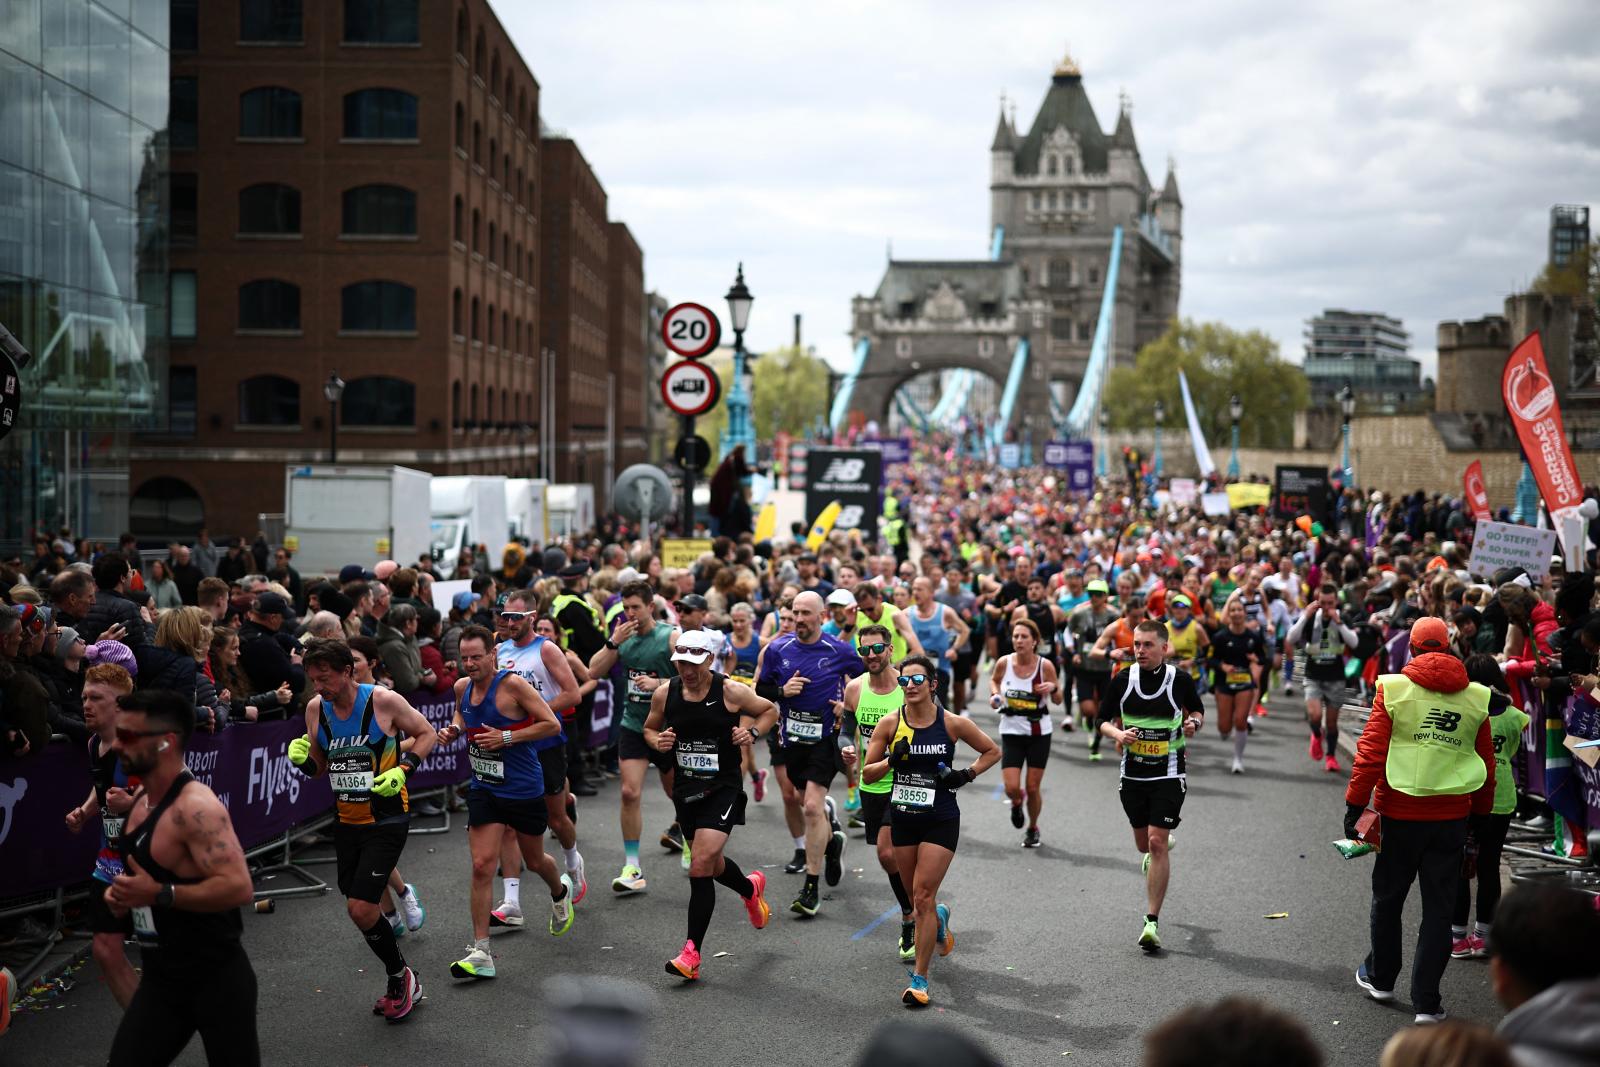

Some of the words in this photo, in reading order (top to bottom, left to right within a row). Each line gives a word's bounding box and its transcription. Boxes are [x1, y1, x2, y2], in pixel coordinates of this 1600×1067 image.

[671, 320, 707, 340] 20
[1532, 421, 1571, 505] CARRERAS
[1486, 531, 1502, 541] GO
[1488, 545, 1501, 553] SO
[1502, 547, 1530, 558] SUPER
[1475, 554, 1505, 566] PROUD
[418, 702, 456, 719] BBOTT
[860, 713, 884, 723] AFR
[1420, 708, 1462, 732] NB
[791, 723, 817, 735] 42772
[1413, 732, 1431, 741] new
[679, 740, 692, 751] tcs
[909, 743, 947, 755] ALLIANCE
[1136, 743, 1160, 754] 7146
[330, 761, 346, 771] tcs
[682, 755, 712, 768] 51784
[337, 775, 367, 788] 41364
[897, 771, 910, 784] tcs
[898, 788, 928, 803] 38559
